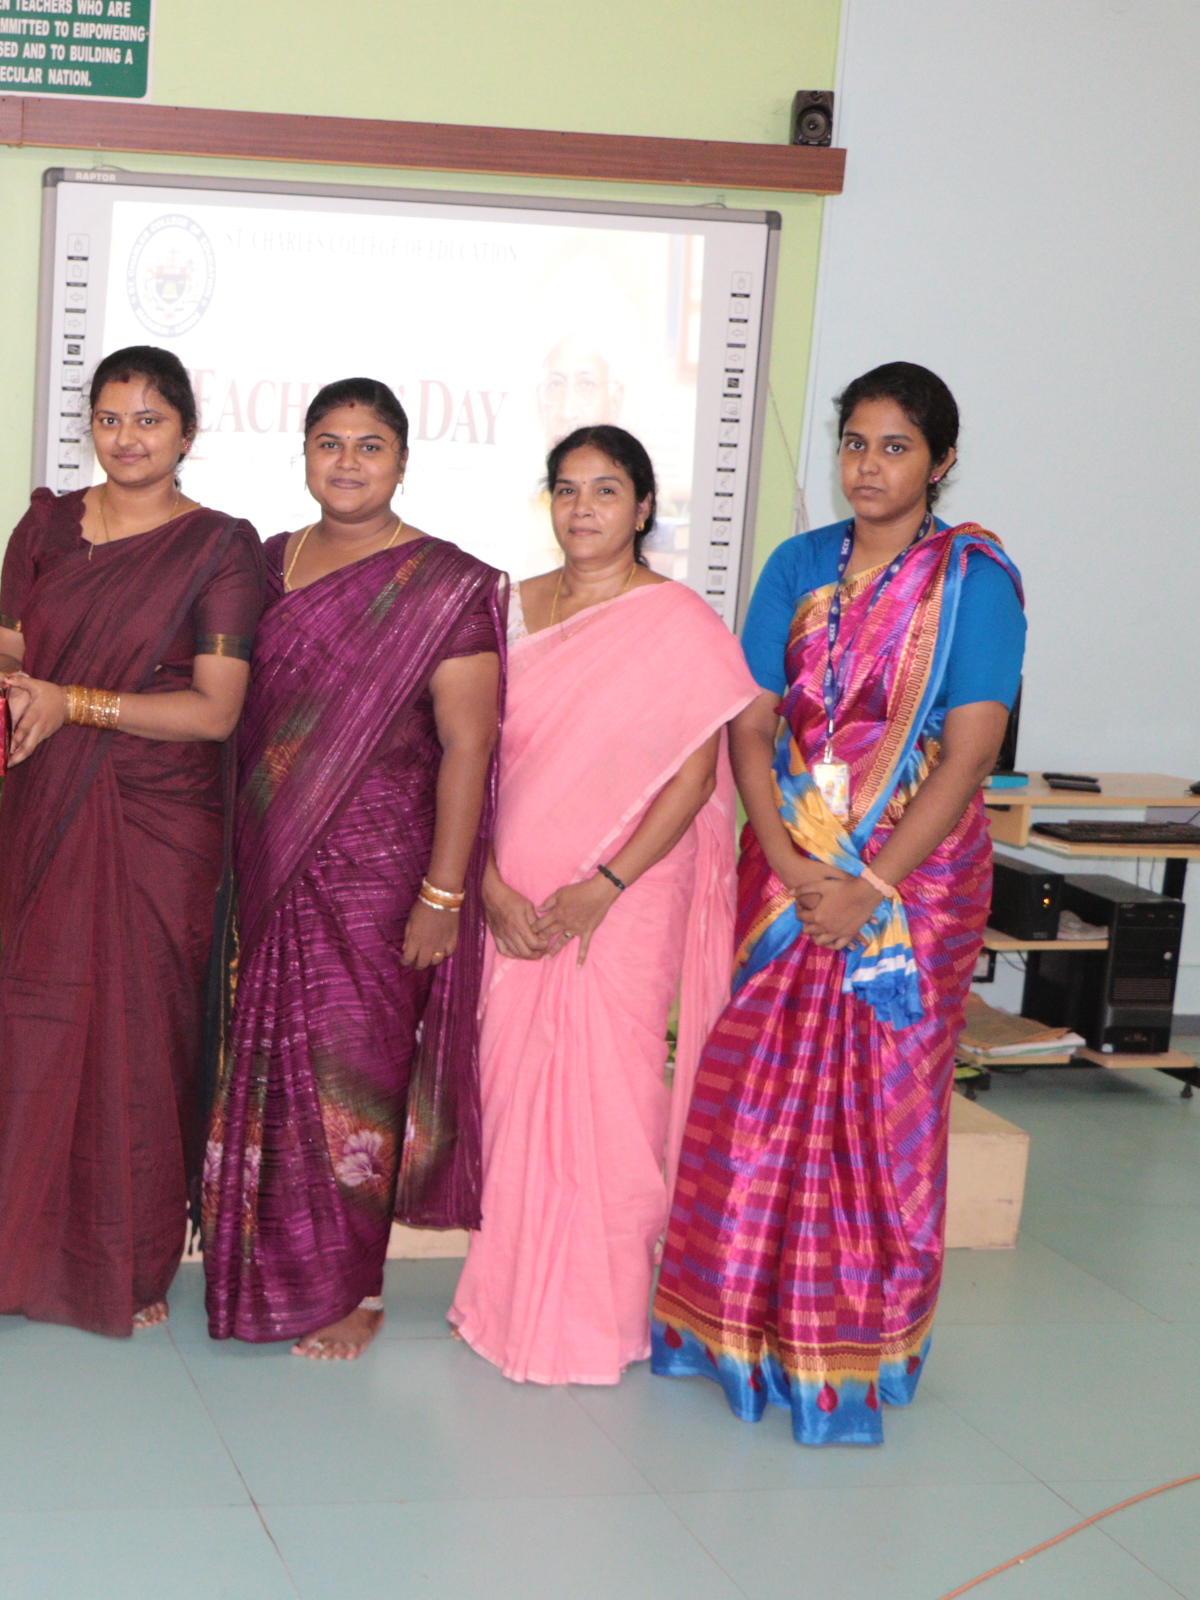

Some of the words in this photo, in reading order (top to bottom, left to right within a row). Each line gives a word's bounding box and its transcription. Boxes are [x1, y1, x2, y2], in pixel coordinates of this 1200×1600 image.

[16, 0, 73, 14] TEACHERS
[77, 0, 103, 16] WHO
[107, 1, 132, 18] ARE
[54, 21, 70, 38] TO
[73, 22, 146, 42] EMPOWERING
[22, 42, 47, 60] AND
[50, 44, 66, 61] TO
[69, 45, 121, 64] BUILDING
[124, 48, 134, 65] A
[47, 68, 92, 87] NATION.
[75, 172, 116, 182] RAPTOR
[251, 229, 325, 254] CHARLES
[330, 233, 399, 257] COLLEGE
[405, 238, 425, 258] OF
[428, 239, 519, 264] EDUCATION
[414, 379, 509, 446] DAY
